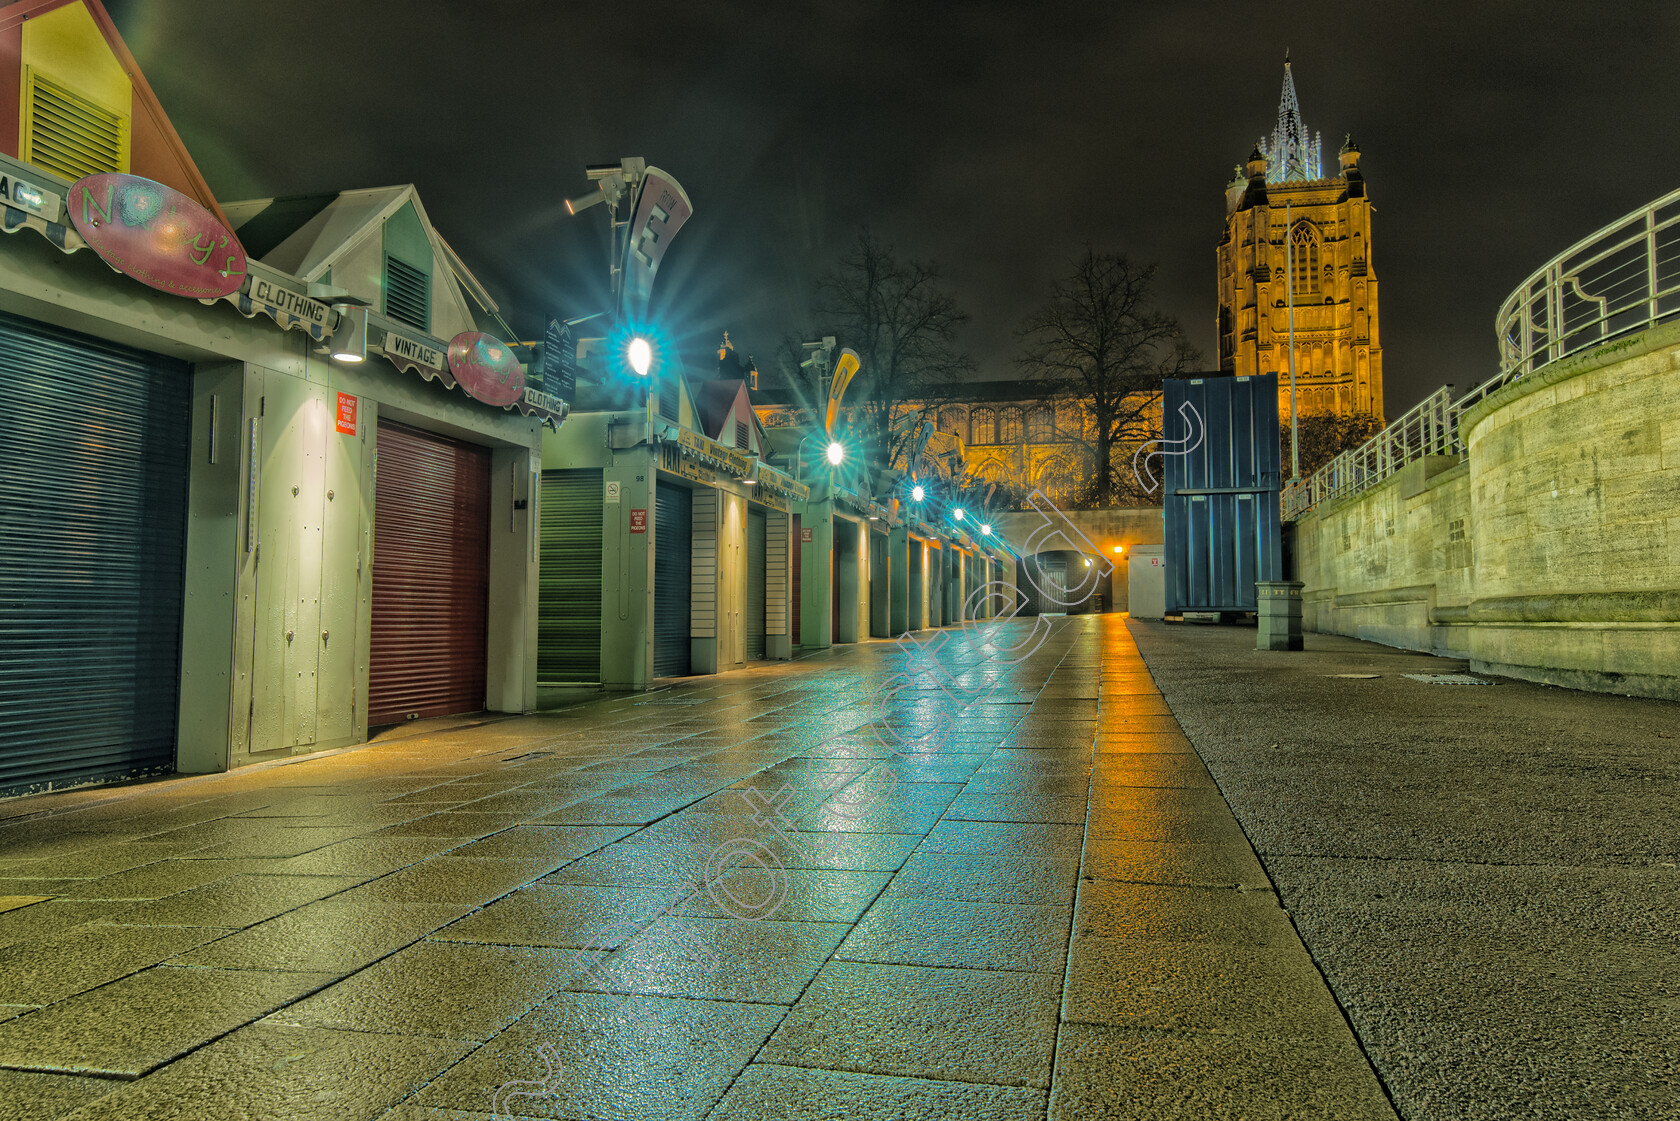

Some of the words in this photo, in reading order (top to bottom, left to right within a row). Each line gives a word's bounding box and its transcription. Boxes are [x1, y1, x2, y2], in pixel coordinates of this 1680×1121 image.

[127, 263, 167, 288] clothing
[256, 281, 325, 322] CLOTHING
[395, 336, 437, 365] VINTAGE
[528, 390, 561, 412] CLOTHING
